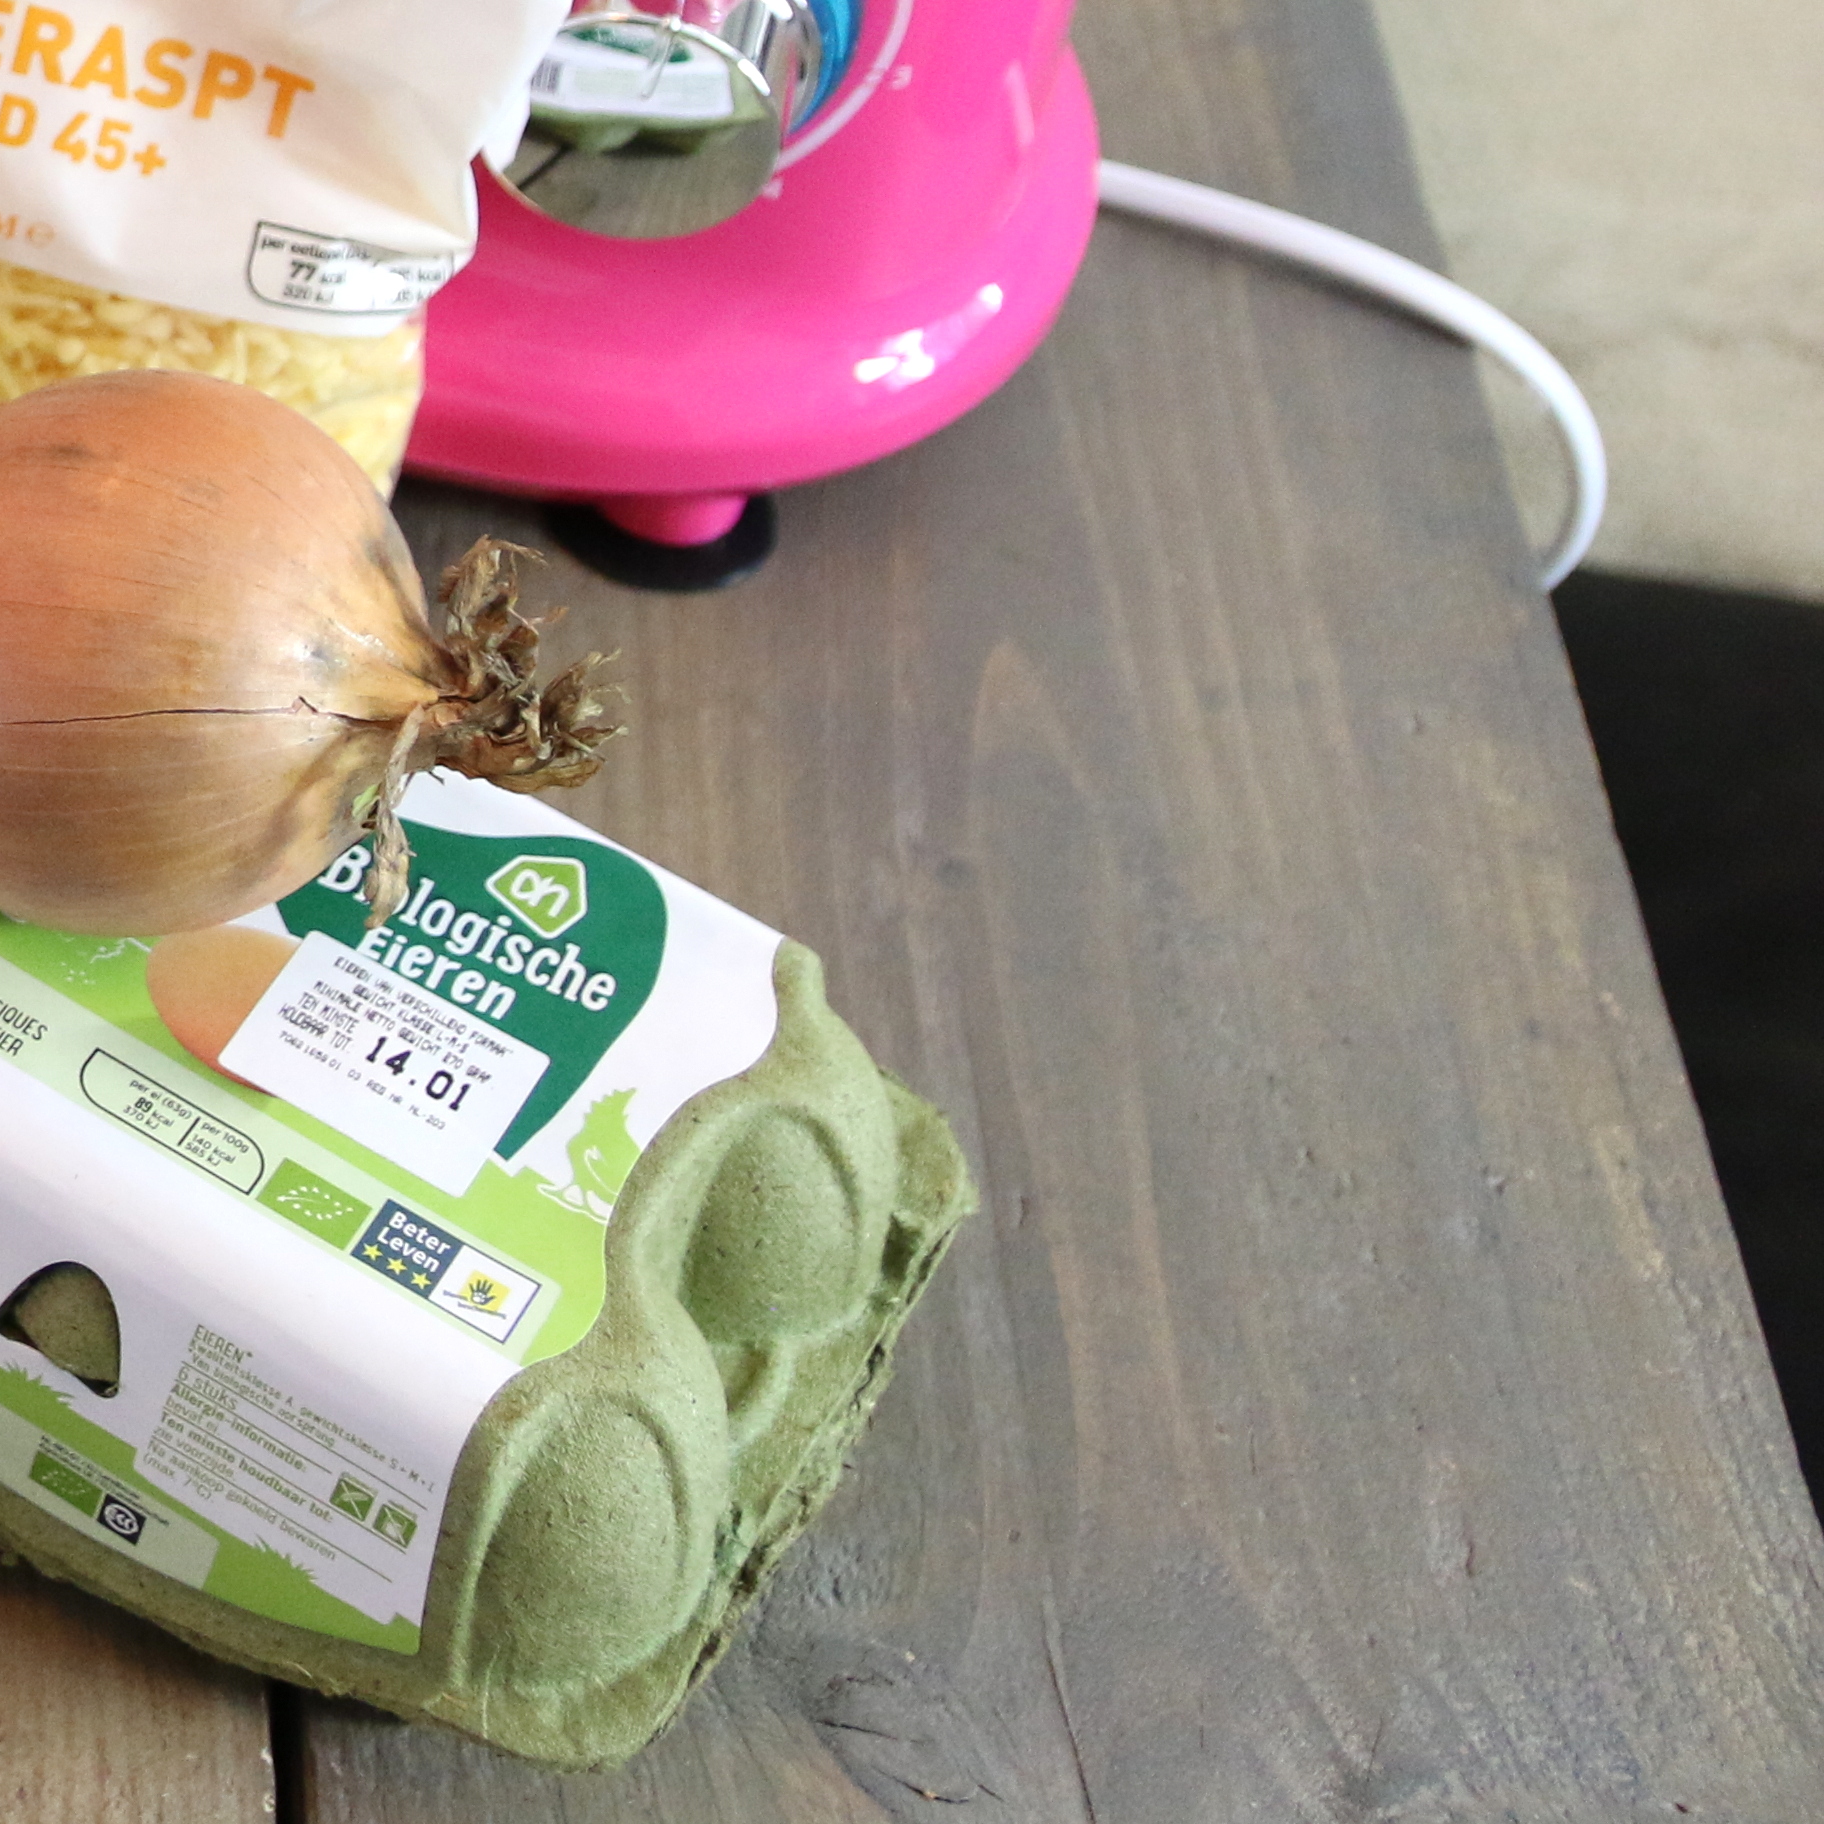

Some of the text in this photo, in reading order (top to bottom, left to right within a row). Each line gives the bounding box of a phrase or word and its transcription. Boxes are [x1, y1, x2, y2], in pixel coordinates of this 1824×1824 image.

[52, 111, 168, 178] 45+
[289, 259, 319, 282] 77
[317, 844, 618, 1012] Blogische
[333, 955, 372, 982] EIEREN
[374, 979, 394, 995] VAN
[395, 990, 468, 1036] VERSCHILLEND
[354, 925, 518, 1021] Eieren
[297, 991, 360, 1036] TEN MINSTE
[312, 980, 364, 1014] MINIMALE
[363, 1008, 397, 1033] NETTO
[397, 1027, 443, 1057] GEWICHT
[351, 983, 397, 1012] GEWICHT
[278, 1003, 330, 1040] HOUDBAAR
[364, 1035, 473, 1112] 14.01
[122, 1104, 144, 1122] 370
[129, 1079, 149, 1093] per
[161, 1095, 194, 1120] (63g)
[134, 1096, 175, 1128] 89 kcal
[191, 1133, 236, 1164] 140 kcal
[200, 1121, 250, 1154] per 100g
[376, 1226, 442, 1273] Leven
[388, 1210, 452, 1256] Beter
[165, 1395, 203, 1424] bevat
[178, 1366, 238, 1411] 6 stuks
[189, 1339, 282, 1400] Kwaliteitsklasse
[299, 1406, 386, 1463] gewichtsklasse
[212, 1367, 275, 1410] biologische
[153, 1425, 174, 1443] zie
[160, 1411, 185, 1433] Ten
[187, 1429, 236, 1464] minste
[238, 1457, 305, 1507] houdbaar
[148, 1438, 166, 1458] Na
[169, 1454, 225, 1493] aankoop
[224, 1488, 277, 1525] gekoeld
[279, 1519, 337, 1562] bewaren
